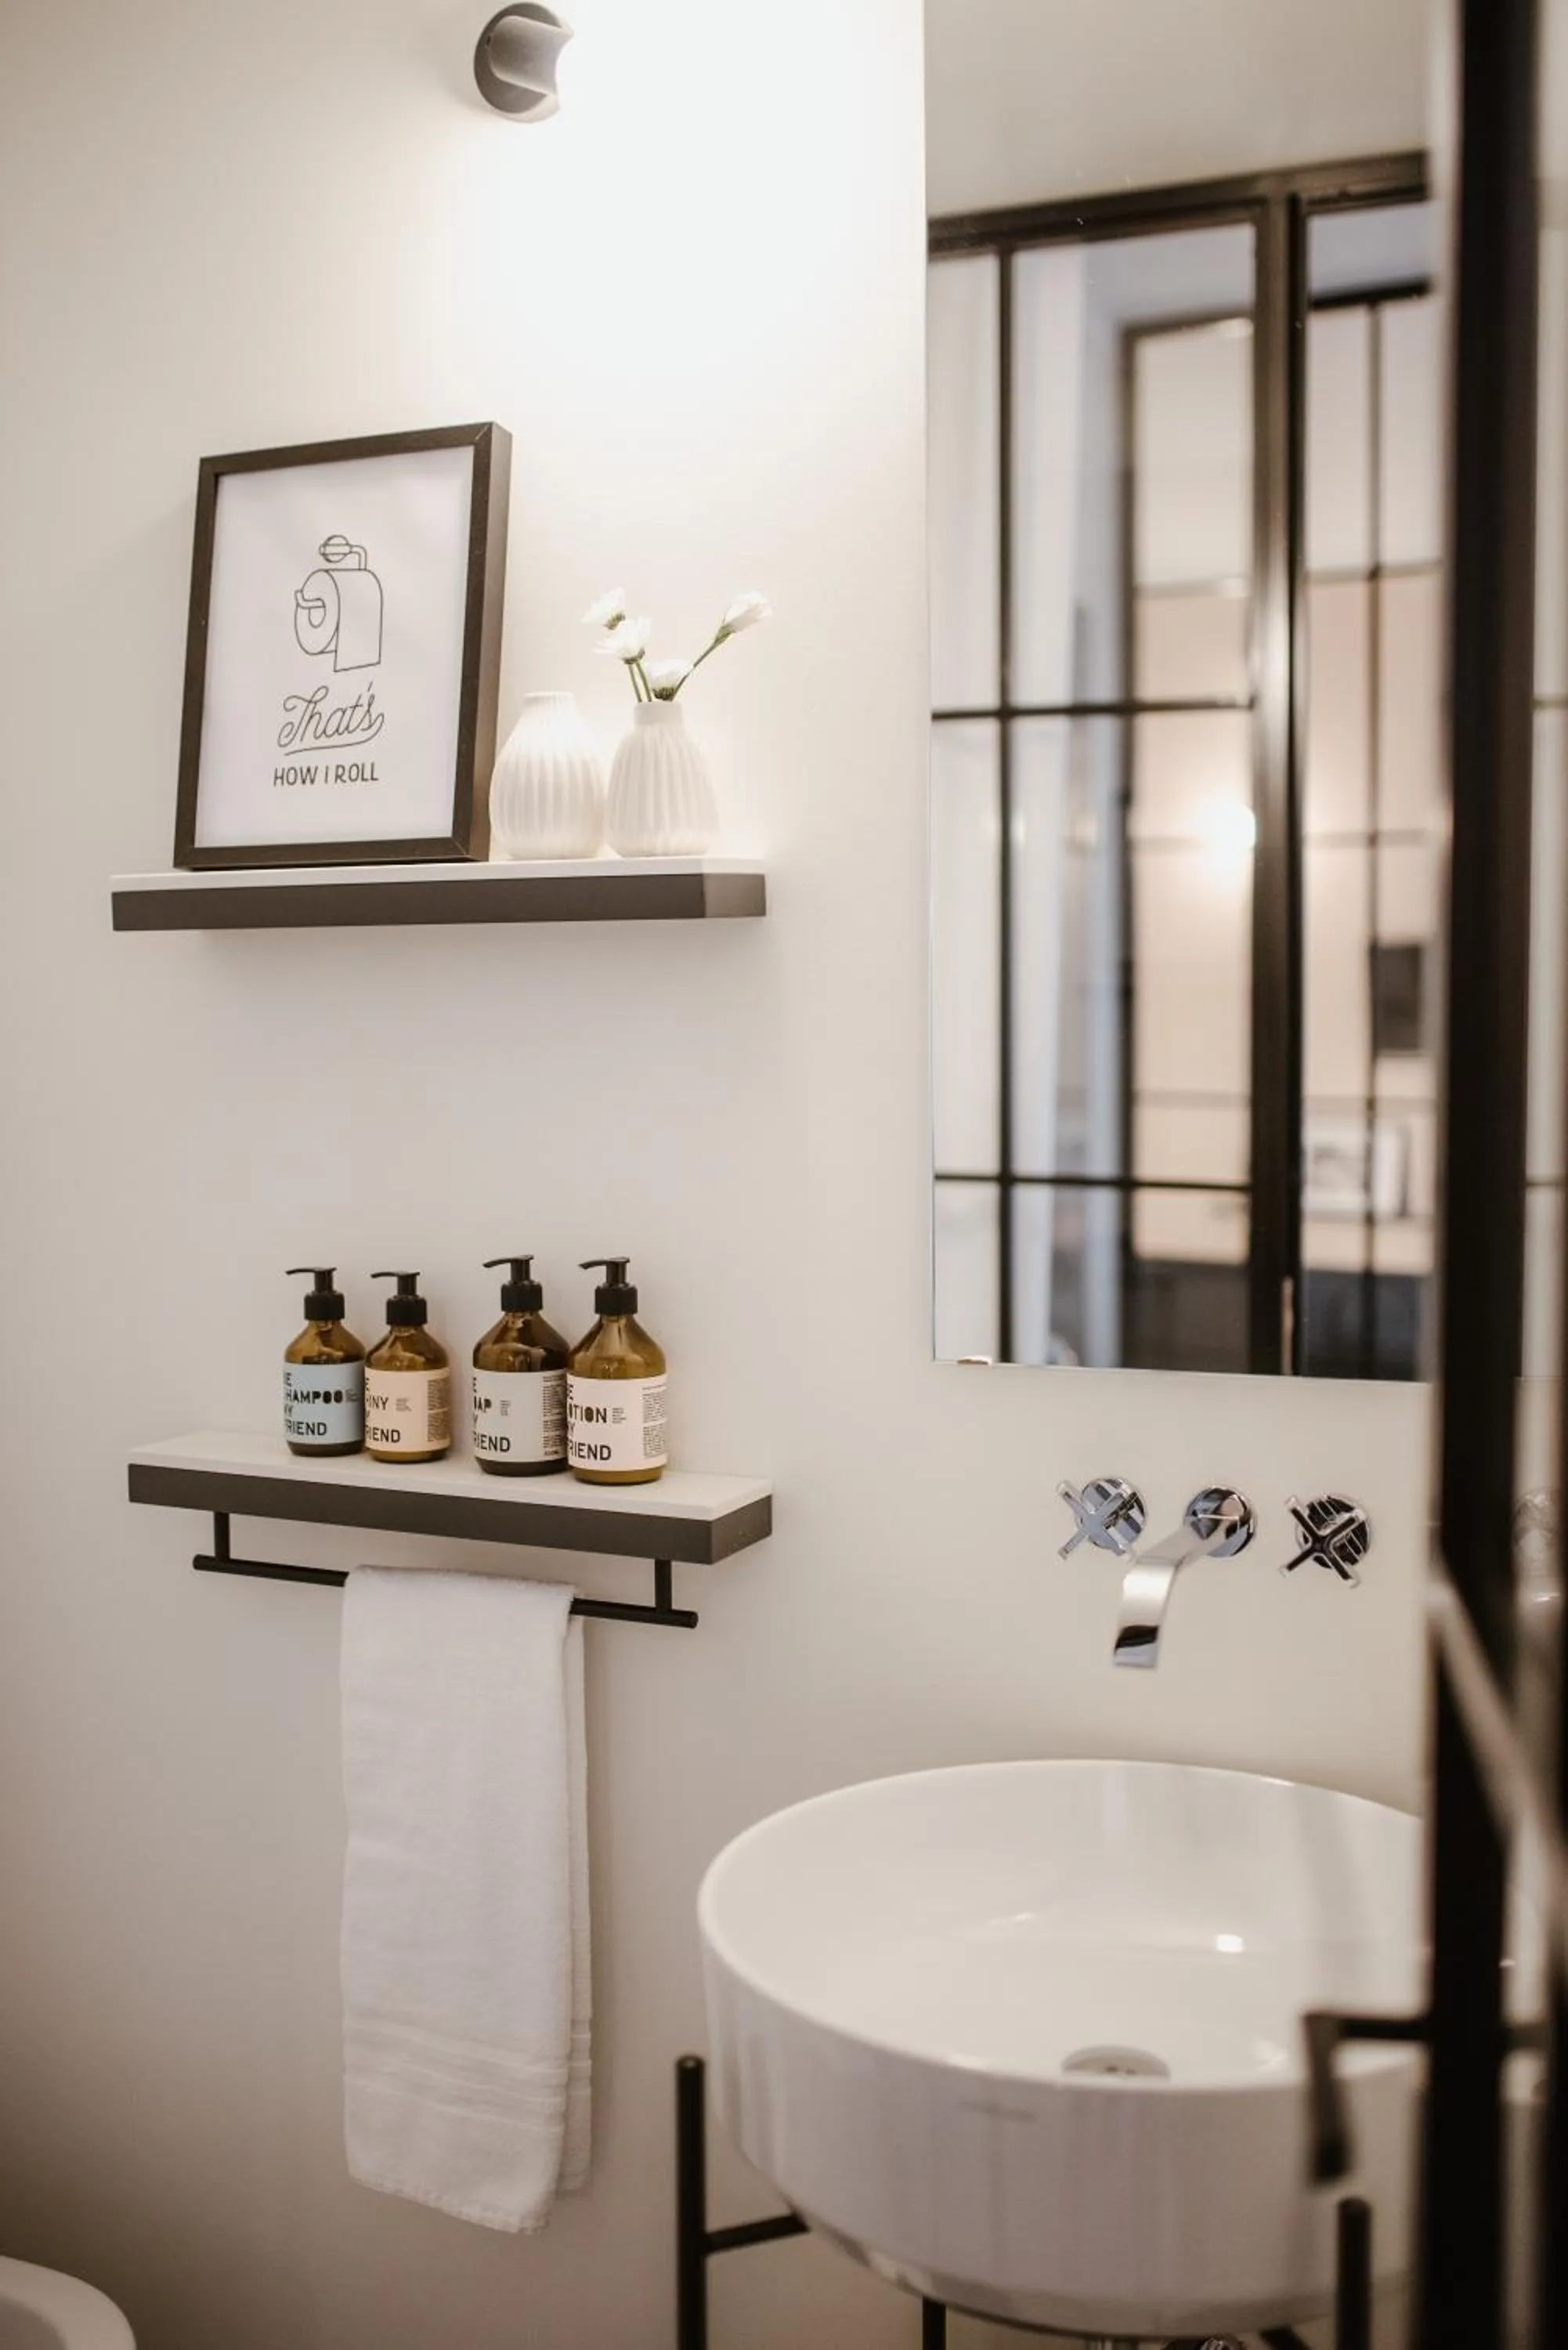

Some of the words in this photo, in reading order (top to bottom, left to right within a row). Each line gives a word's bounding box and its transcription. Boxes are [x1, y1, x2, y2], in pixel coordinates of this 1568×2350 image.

[277, 682, 385, 756] That's
[274, 765, 319, 786] HOW
[324, 765, 329, 784] I
[334, 762, 379, 783] ROLL
